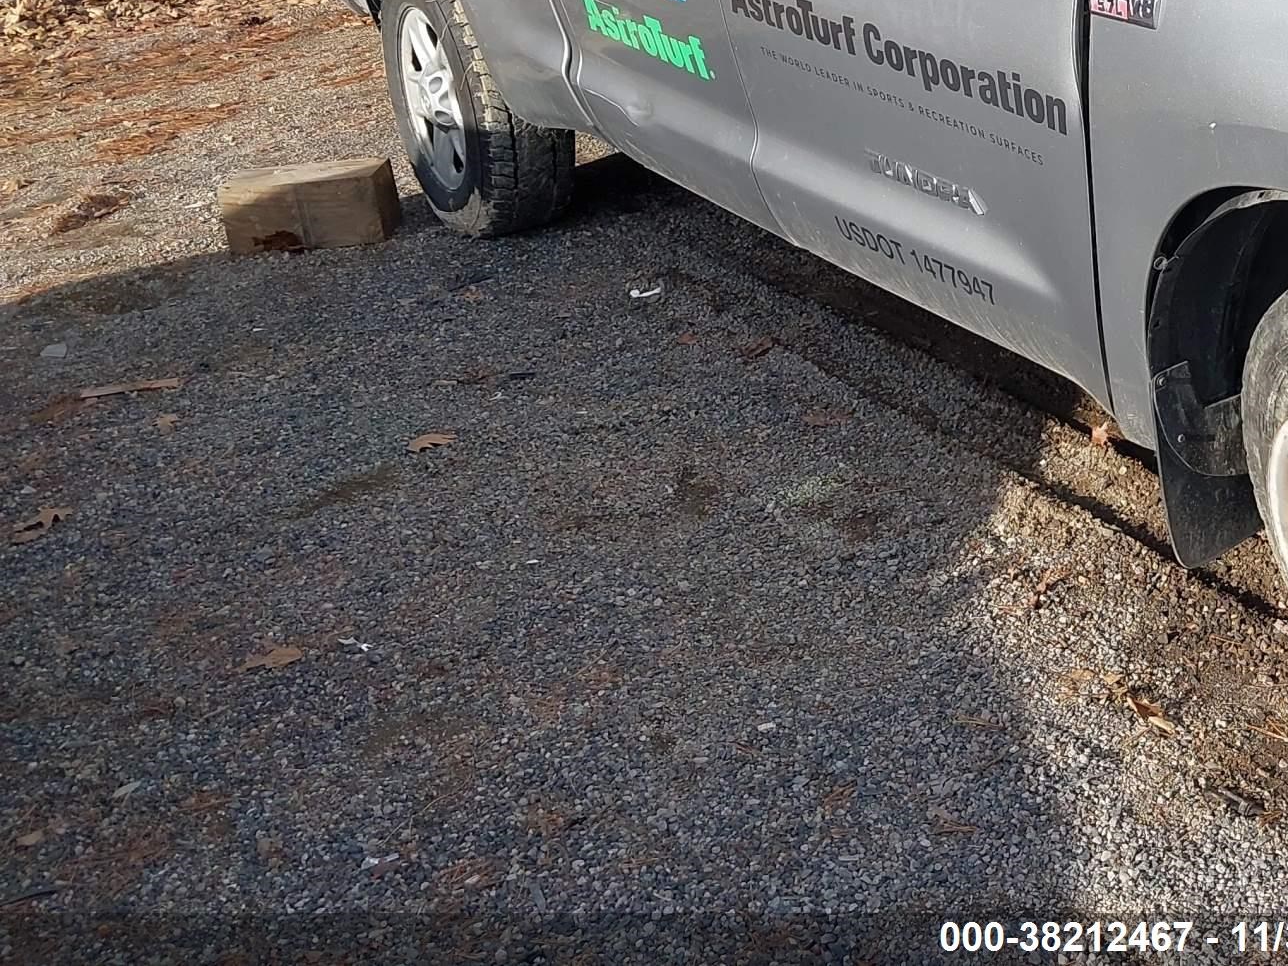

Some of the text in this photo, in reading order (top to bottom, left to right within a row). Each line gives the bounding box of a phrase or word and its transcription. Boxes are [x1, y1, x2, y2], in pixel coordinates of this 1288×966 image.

[761, 46, 778, 60] THE
[780, 53, 812, 73] WORLD
[815, 66, 850, 87] LEADER
[853, 81, 864, 93] IN
[867, 86, 905, 108] SPORTS
[918, 105, 986, 139] RECREATION
[989, 133, 1045, 166] SURFACES
[863, 22, 1068, 136] Corporation
[835, 215, 995, 306] USDOT 1477947
